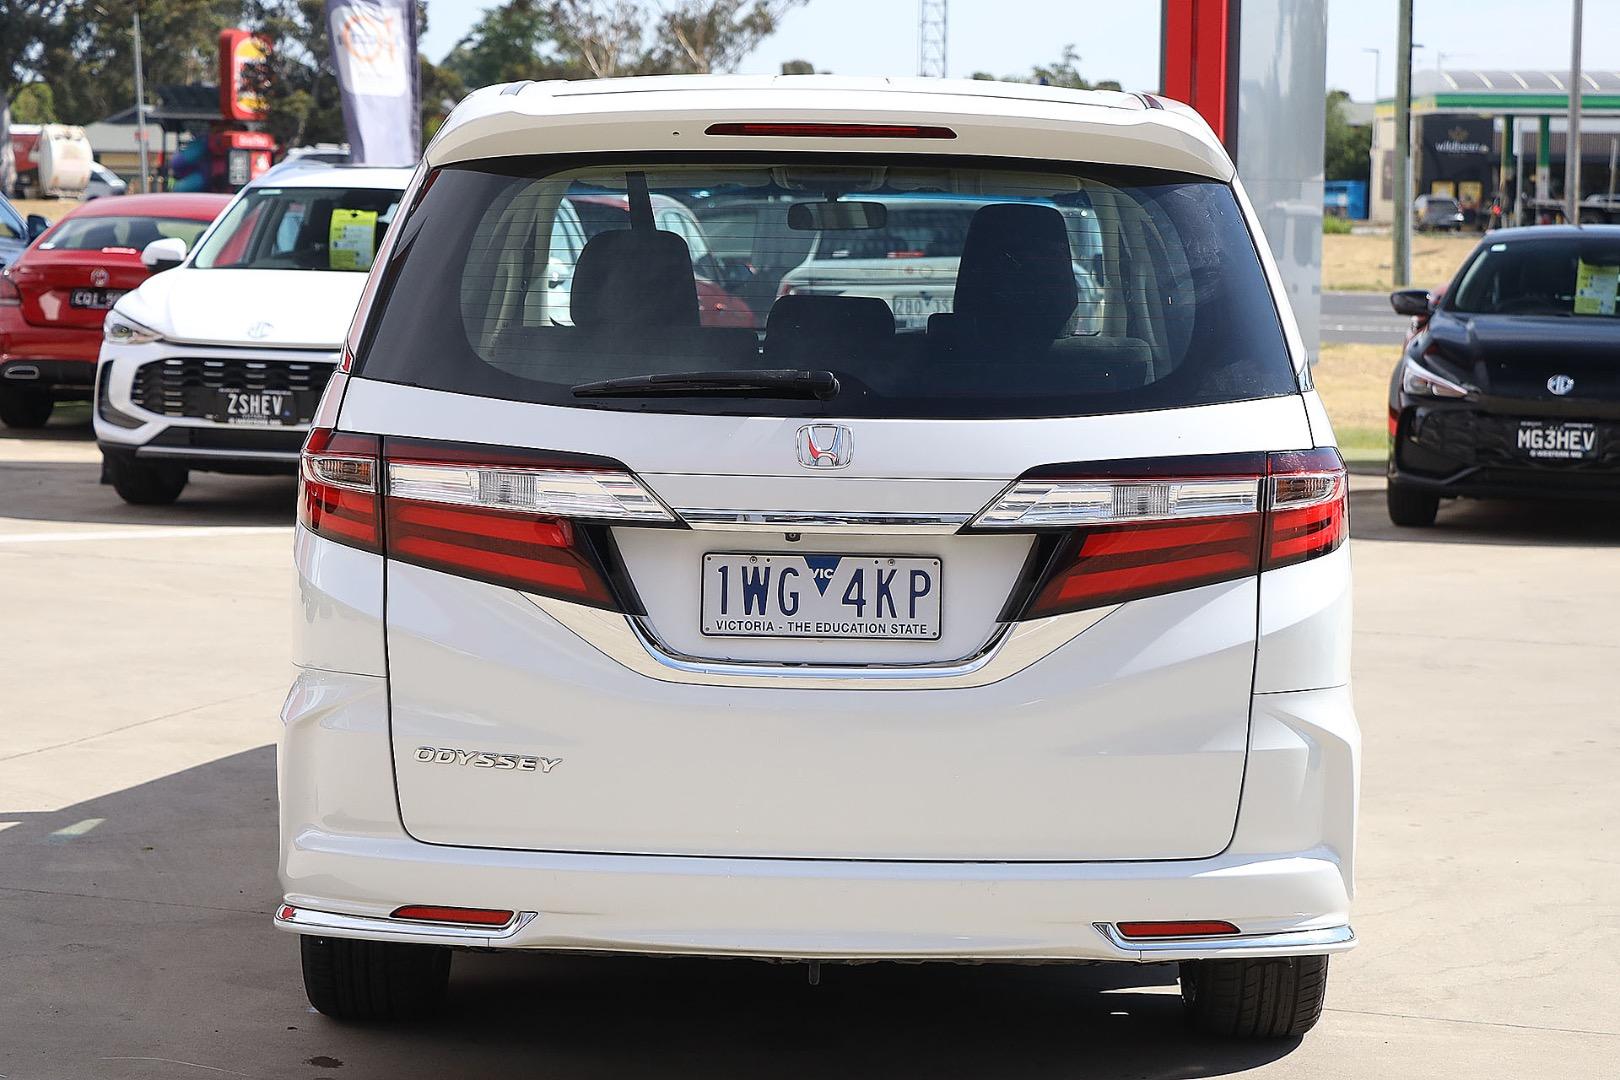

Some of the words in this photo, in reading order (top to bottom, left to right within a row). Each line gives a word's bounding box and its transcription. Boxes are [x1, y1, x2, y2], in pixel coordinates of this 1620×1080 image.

[227, 393, 283, 416] ZSHEV
[1517, 429, 1595, 451] MG3HEV
[810, 568, 834, 580] VIC
[717, 565, 800, 616] 1WG
[842, 569, 931, 618] 4KP
[716, 620, 774, 632] VICTORIA
[787, 621, 811, 633] THE
[816, 622, 886, 635] EDUCATION
[891, 623, 927, 635] STATE
[413, 746, 563, 773] ODYSSEY
